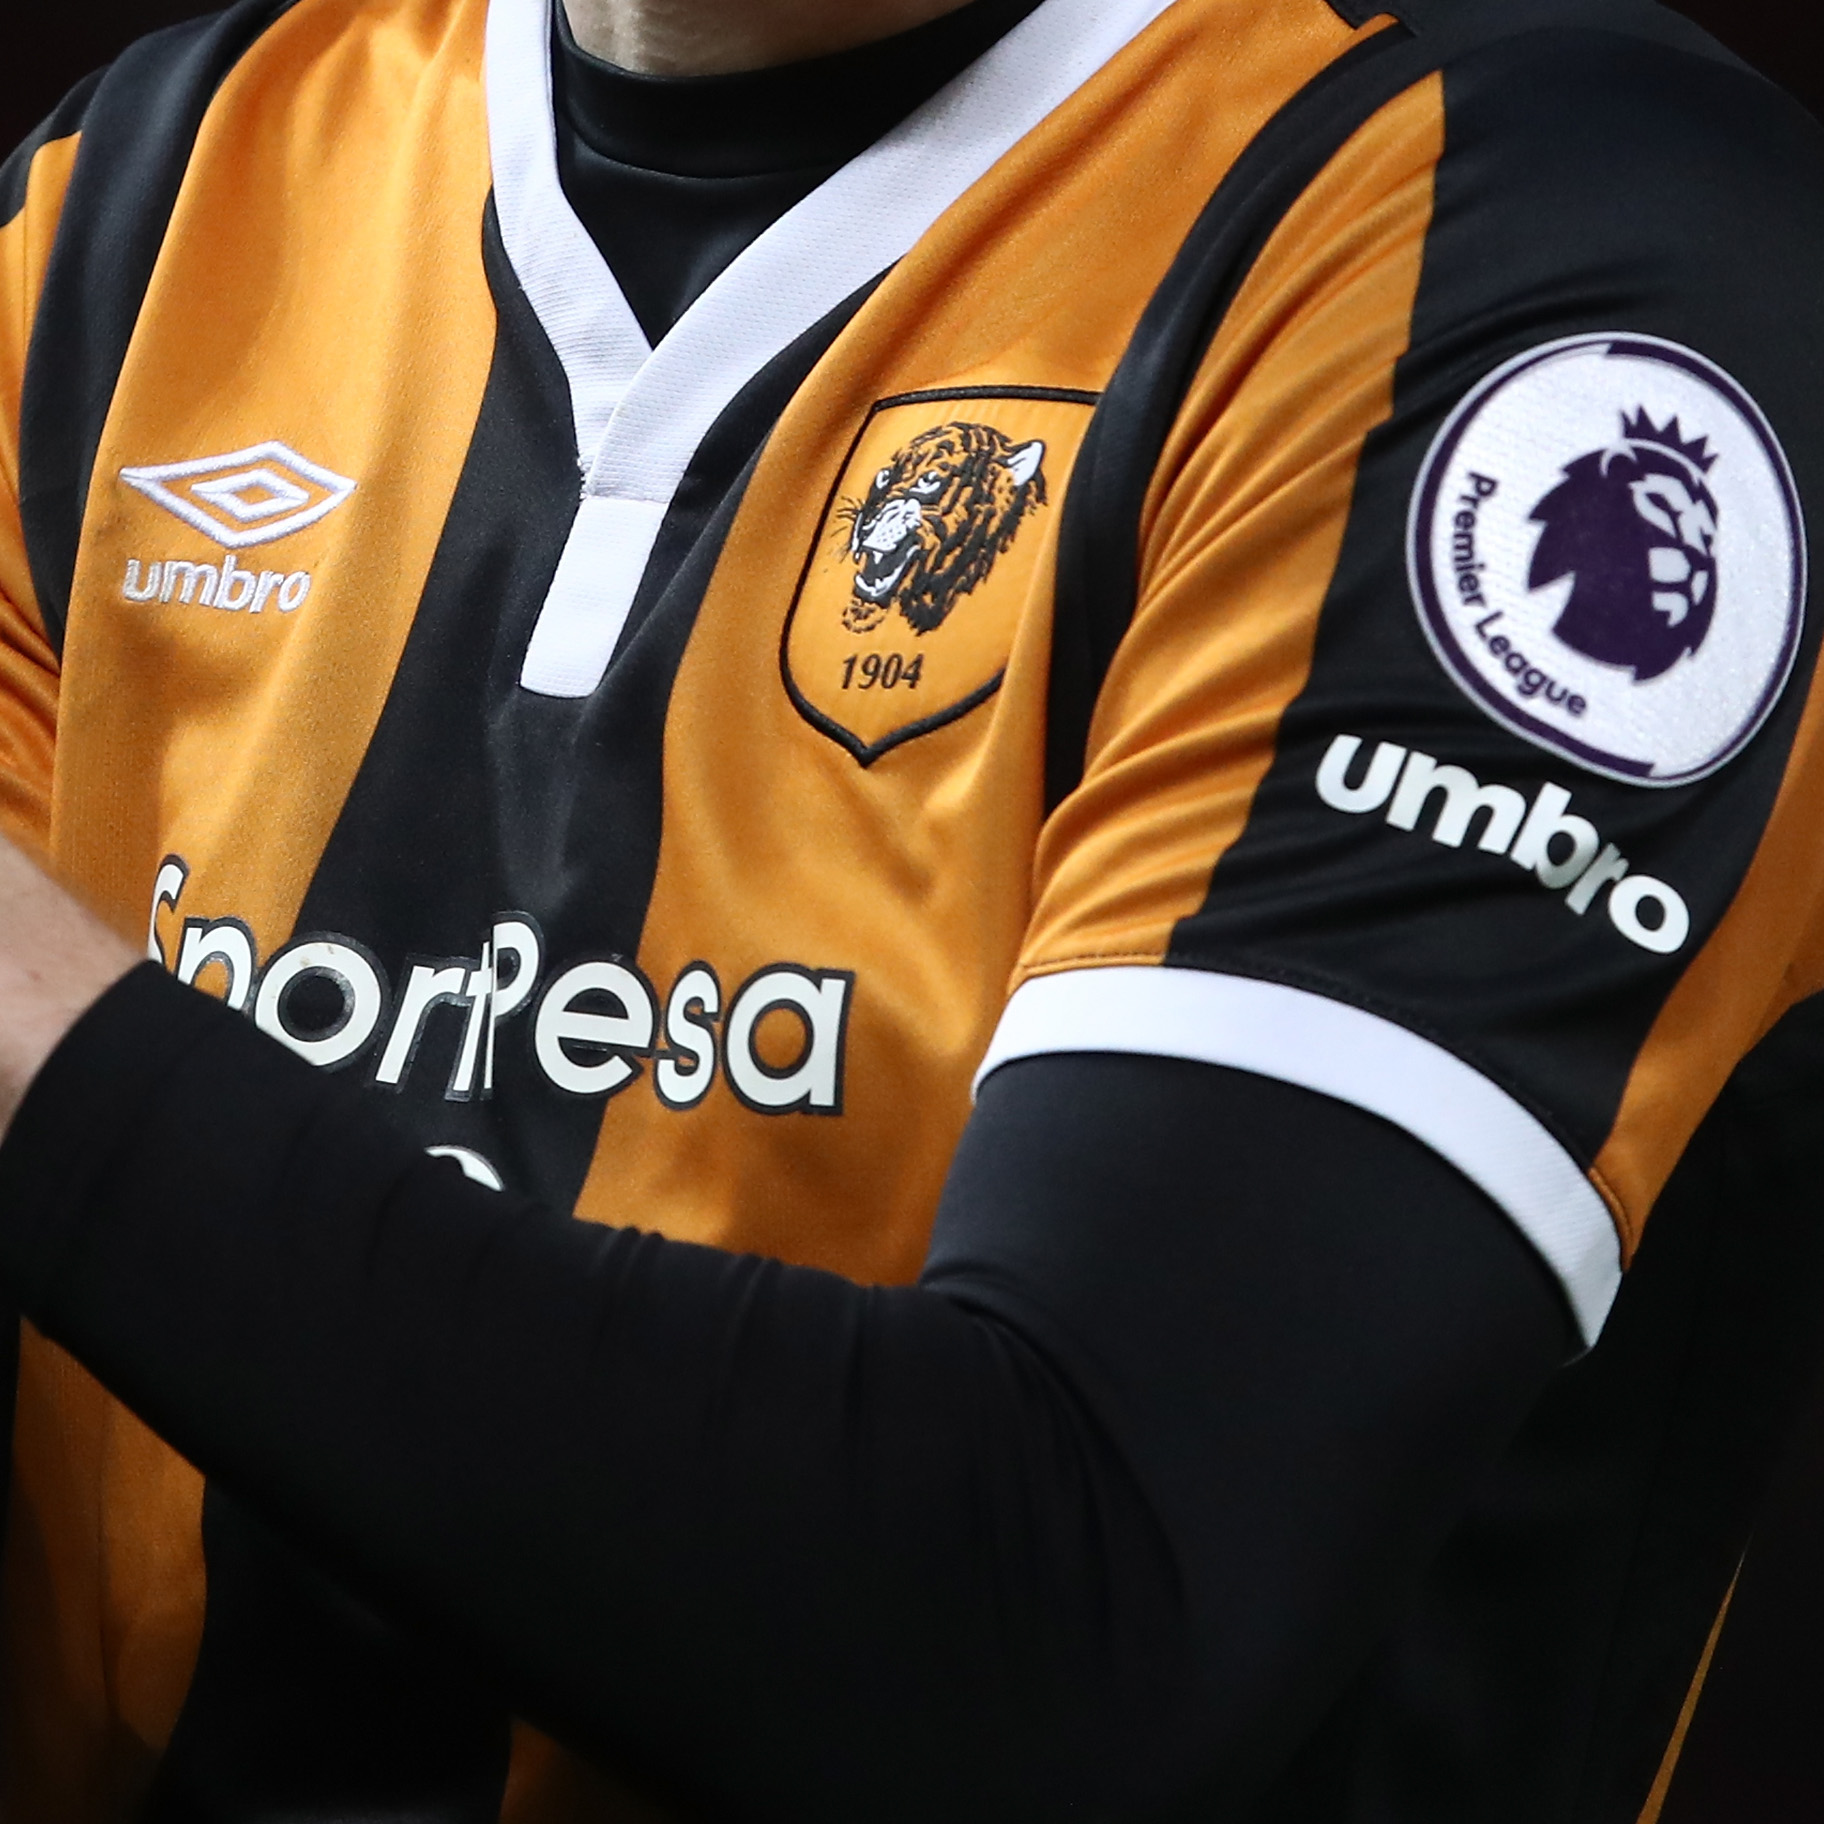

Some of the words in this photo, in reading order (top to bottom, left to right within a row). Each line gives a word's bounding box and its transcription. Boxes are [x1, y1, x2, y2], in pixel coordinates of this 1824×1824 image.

[122, 554, 311, 613] umbro
[1450, 470, 1497, 608] Premier
[1474, 610, 1589, 718] League
[841, 653, 924, 690] 1904
[1314, 733, 1690, 955] umbro
